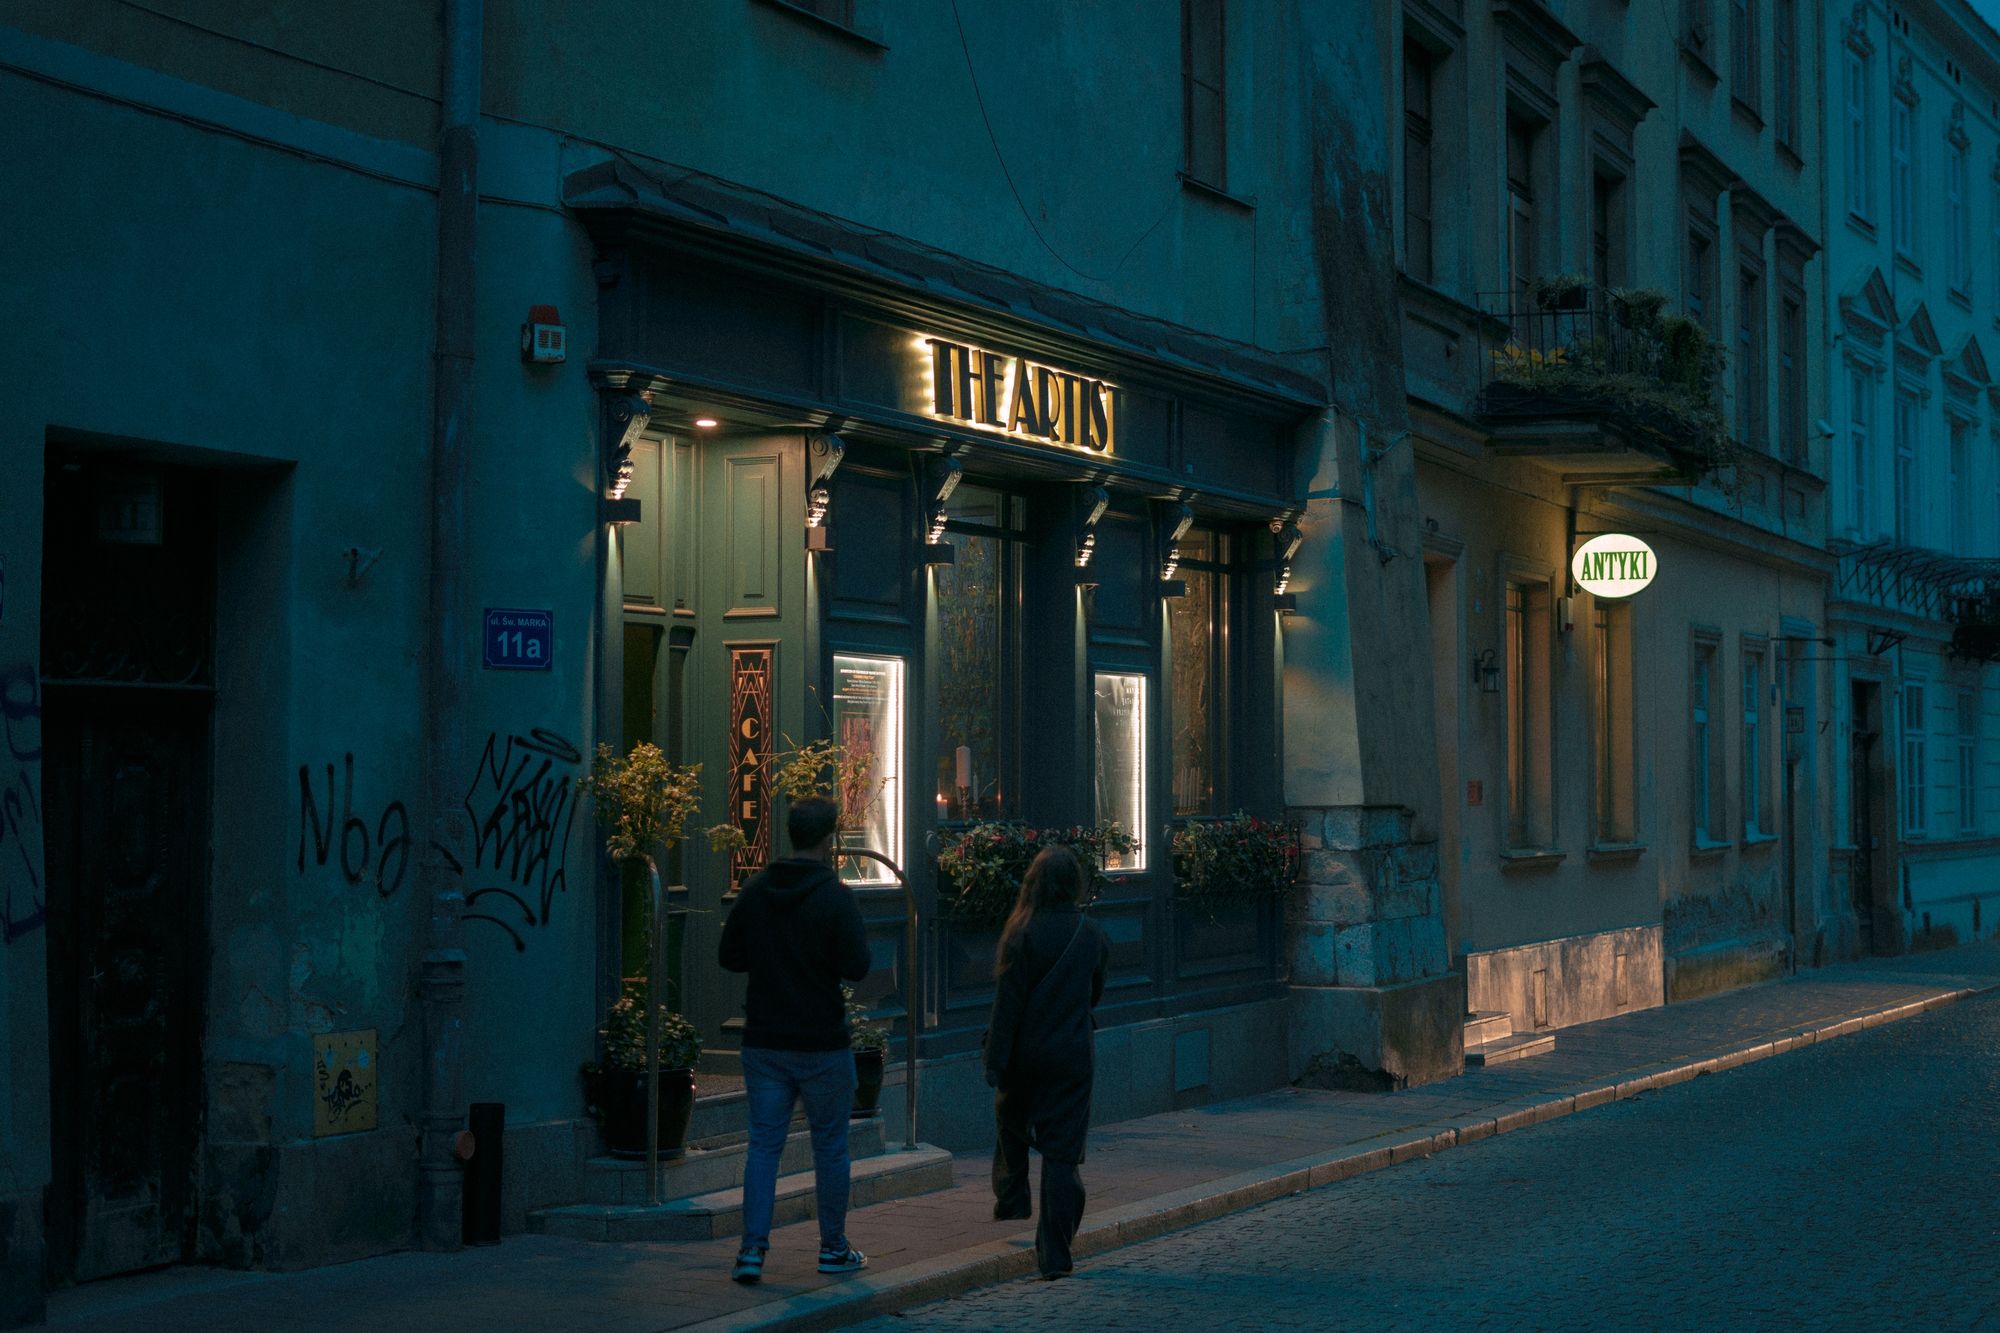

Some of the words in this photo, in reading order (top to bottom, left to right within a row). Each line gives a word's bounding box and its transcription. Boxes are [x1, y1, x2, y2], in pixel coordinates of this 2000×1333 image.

[925, 339, 1007, 428] THE
[1008, 357, 1122, 454] ARTIST
[1580, 551, 1648, 580] ANTYKI
[490, 617, 500, 625] ul.
[502, 616, 516, 626] Św.
[517, 618, 547, 627] MARKA
[497, 631, 541, 658] 11a
[741, 717, 760, 819] CAFE
